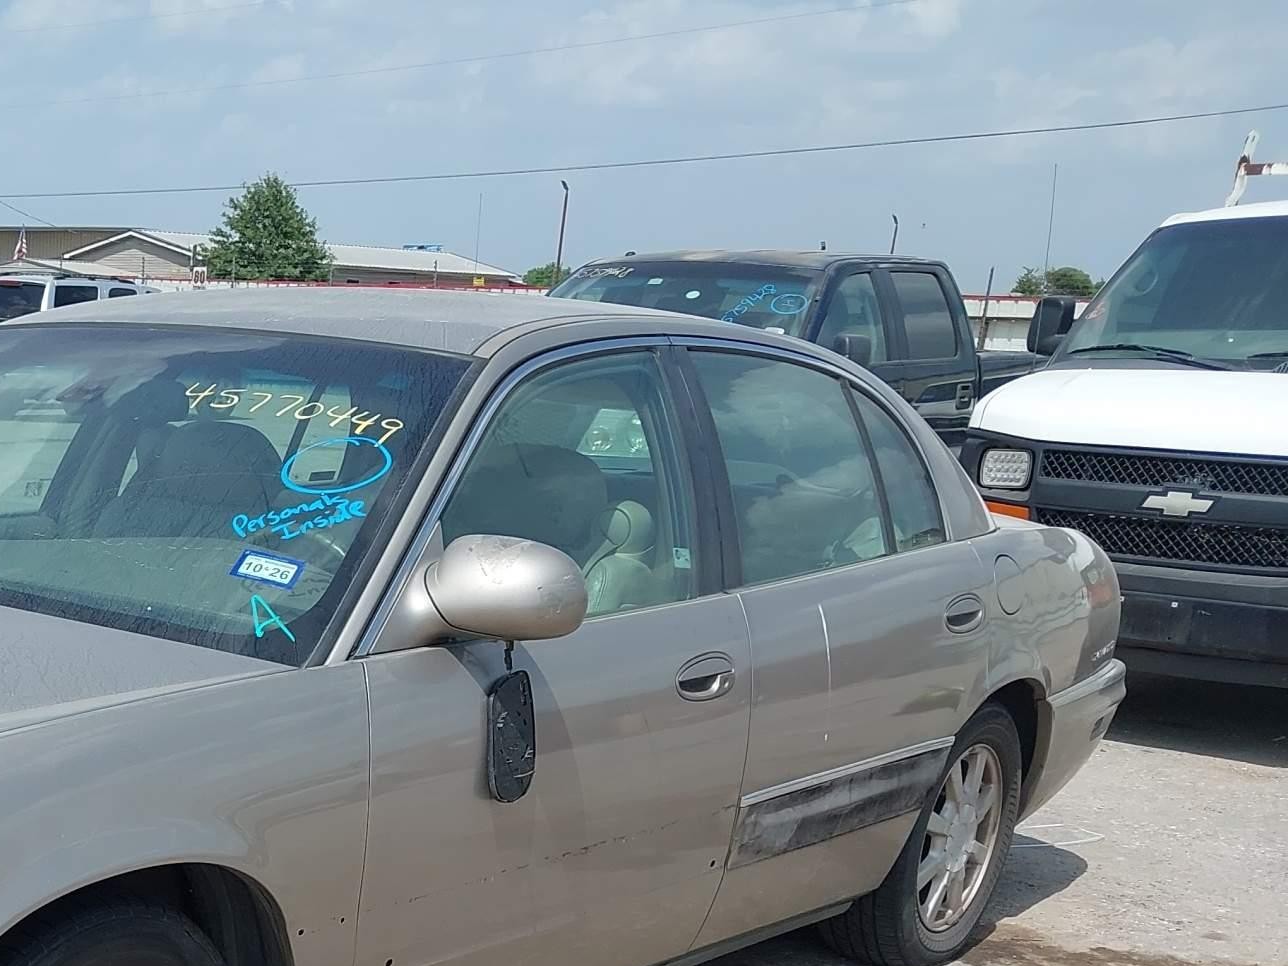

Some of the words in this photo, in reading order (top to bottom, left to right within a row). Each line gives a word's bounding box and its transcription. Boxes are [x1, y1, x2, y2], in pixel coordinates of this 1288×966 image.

[185, 382, 404, 447] 45770449
[271, 500, 367, 540] Inside
[250, 594, 296, 643] A
